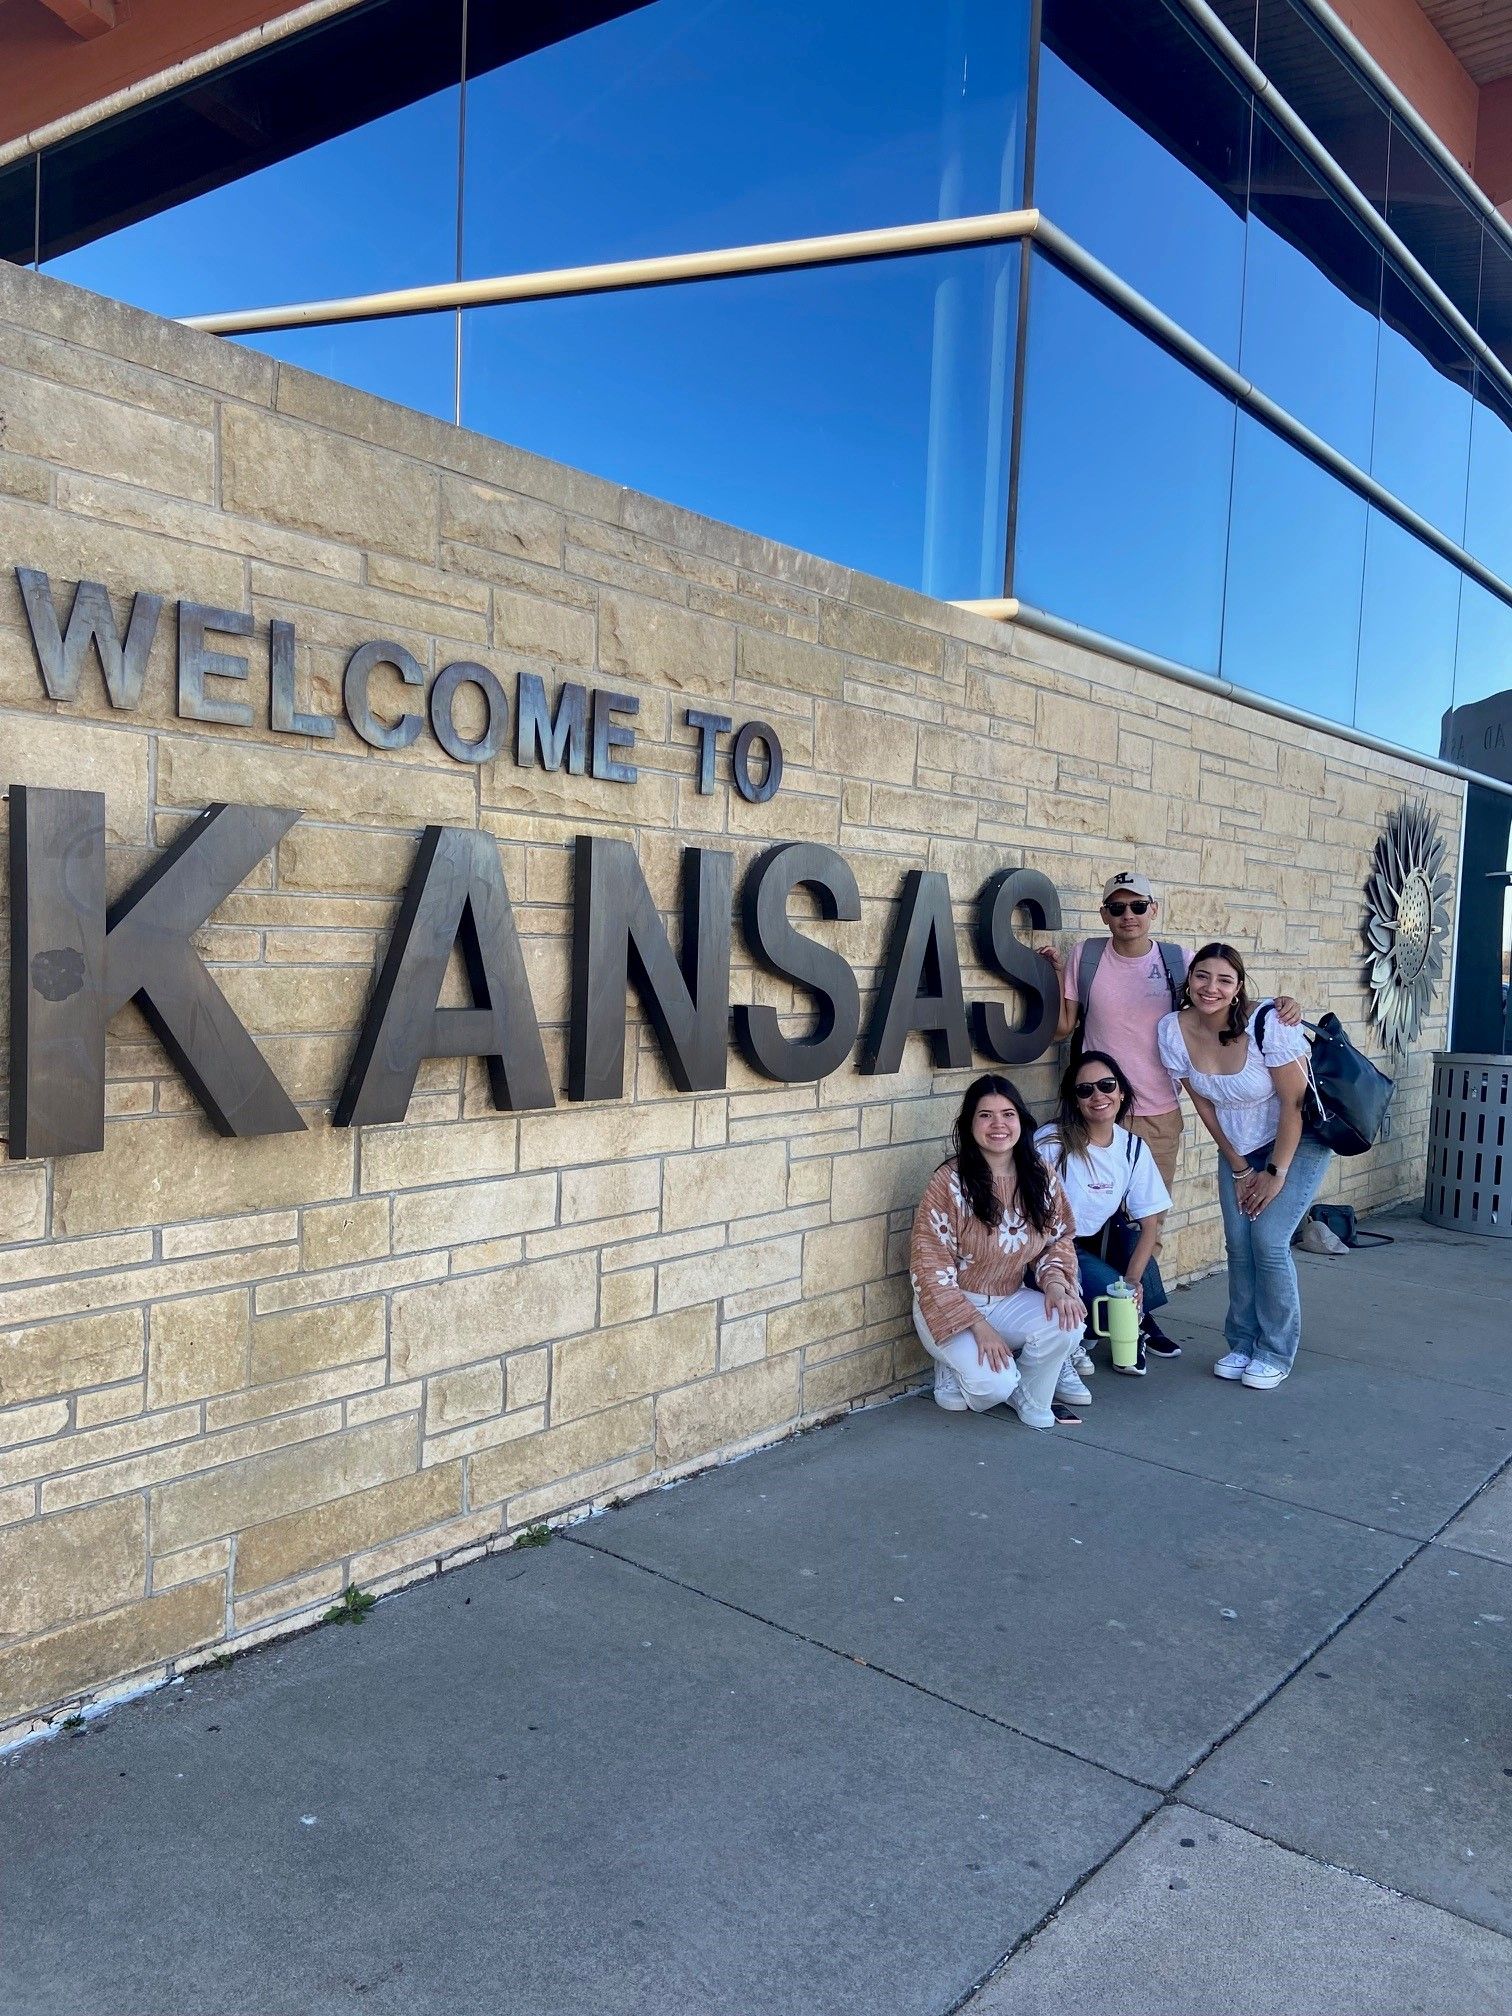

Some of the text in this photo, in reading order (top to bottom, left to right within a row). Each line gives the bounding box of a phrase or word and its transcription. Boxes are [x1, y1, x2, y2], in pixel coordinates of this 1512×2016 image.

[15, 567, 783, 803] WELCOME TO
[9, 785, 1062, 1160] KANSAS
[1147, 963, 1162, 979] A
